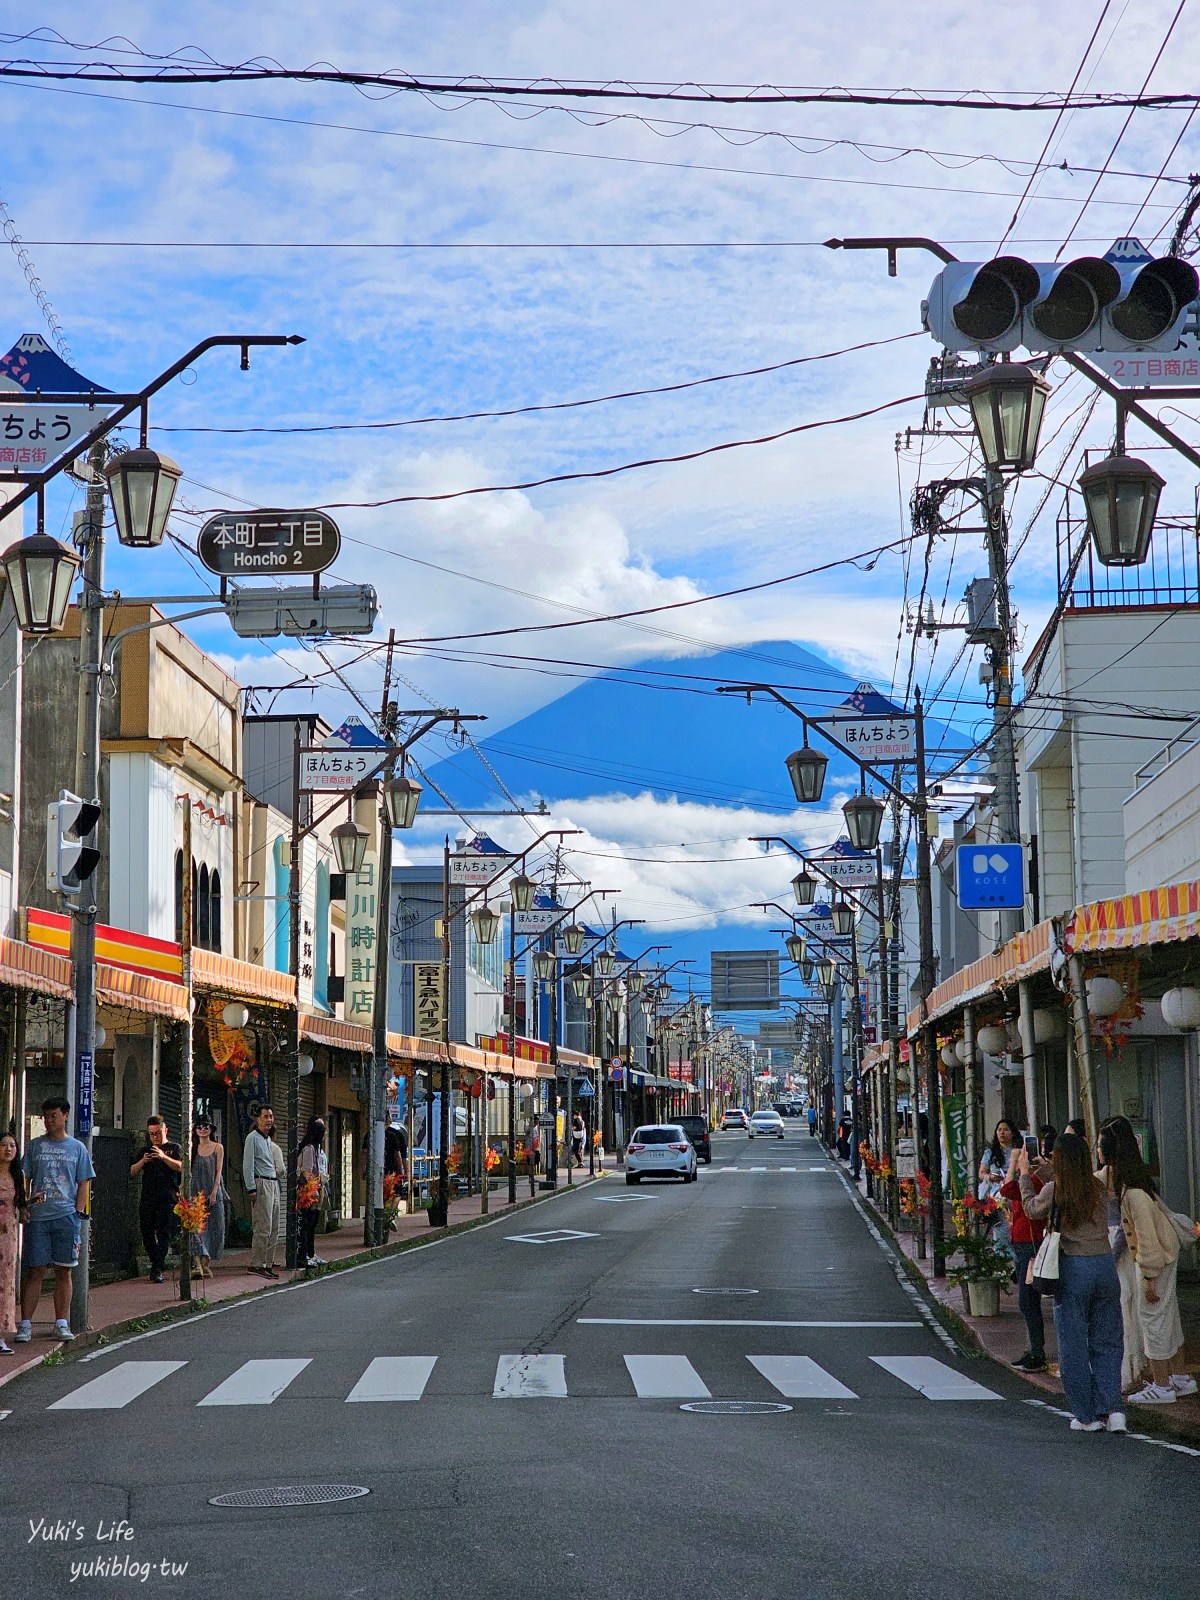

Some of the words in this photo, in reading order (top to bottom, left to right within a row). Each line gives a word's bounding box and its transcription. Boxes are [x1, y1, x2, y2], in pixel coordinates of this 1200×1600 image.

[2, 413, 72, 441] ちょう
[213, 521, 323, 549] 本町二丁目
[234, 551, 287, 567] Honcho
[292, 551, 303, 565] 2
[845, 724, 910, 743] ほんちょう
[858, 743, 910, 755] 2丁目商店街
[307, 757, 366, 772] ほんちょう
[306, 775, 354, 785] 2丁目商店街
[453, 861, 497, 872] ほんちょう
[830, 862, 873, 875] ほんちょう
[975, 876, 1007, 885] KOSÉ
[518, 914, 553, 923] ほんちょう
[815, 923, 834, 931] ほんち
[418, 966, 441, 1040] 富士急ハイラン
